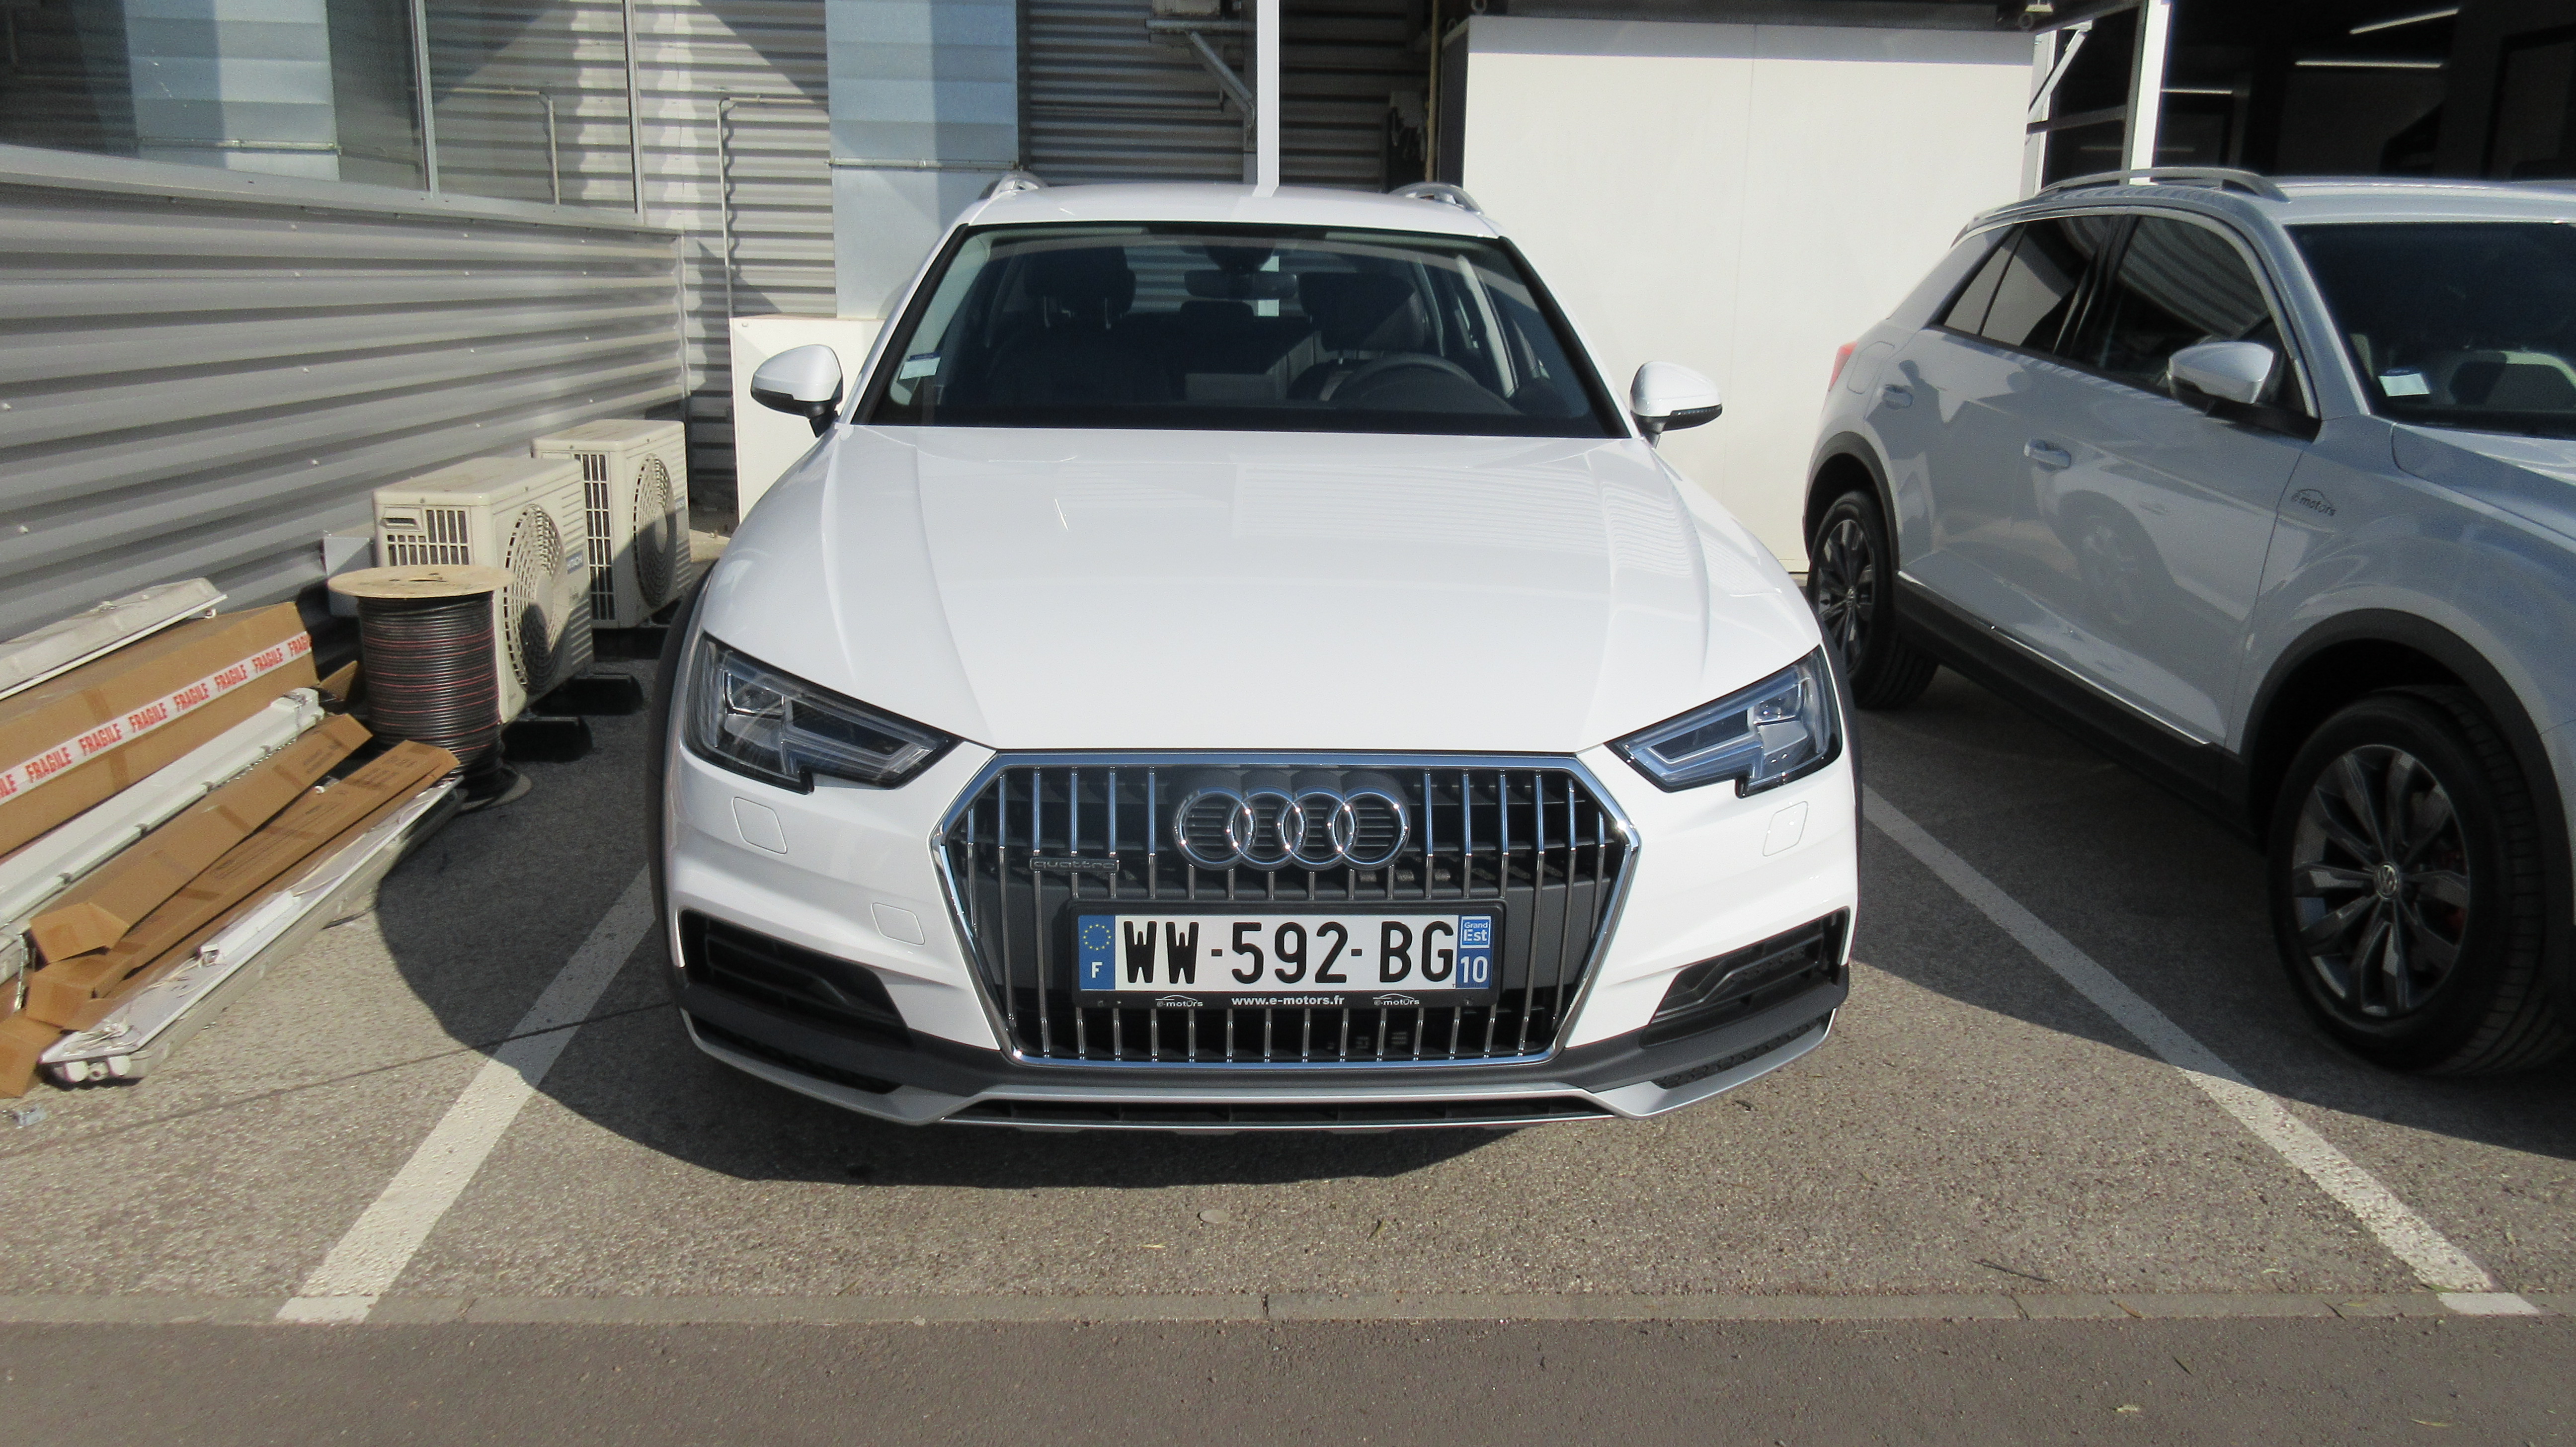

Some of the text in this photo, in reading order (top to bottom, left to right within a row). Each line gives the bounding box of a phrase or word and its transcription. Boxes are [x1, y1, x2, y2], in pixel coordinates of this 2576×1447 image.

[25, 746, 73, 783] FRAGILE
[78, 724, 123, 756] FRAGILE
[128, 703, 167, 732] FRAGILE
[173, 683, 210, 712] FRAGILE
[214, 664, 247, 692] FRAGILE
[252, 647, 283, 673] FRAGILE
[1463, 929, 1488, 941] Est
[1124, 921, 1453, 984] WW-592-BG
[1091, 962, 1103, 978] F
[1460, 956, 1488, 983] 10
[1231, 995, 1345, 1006] www.e-motors.fr
